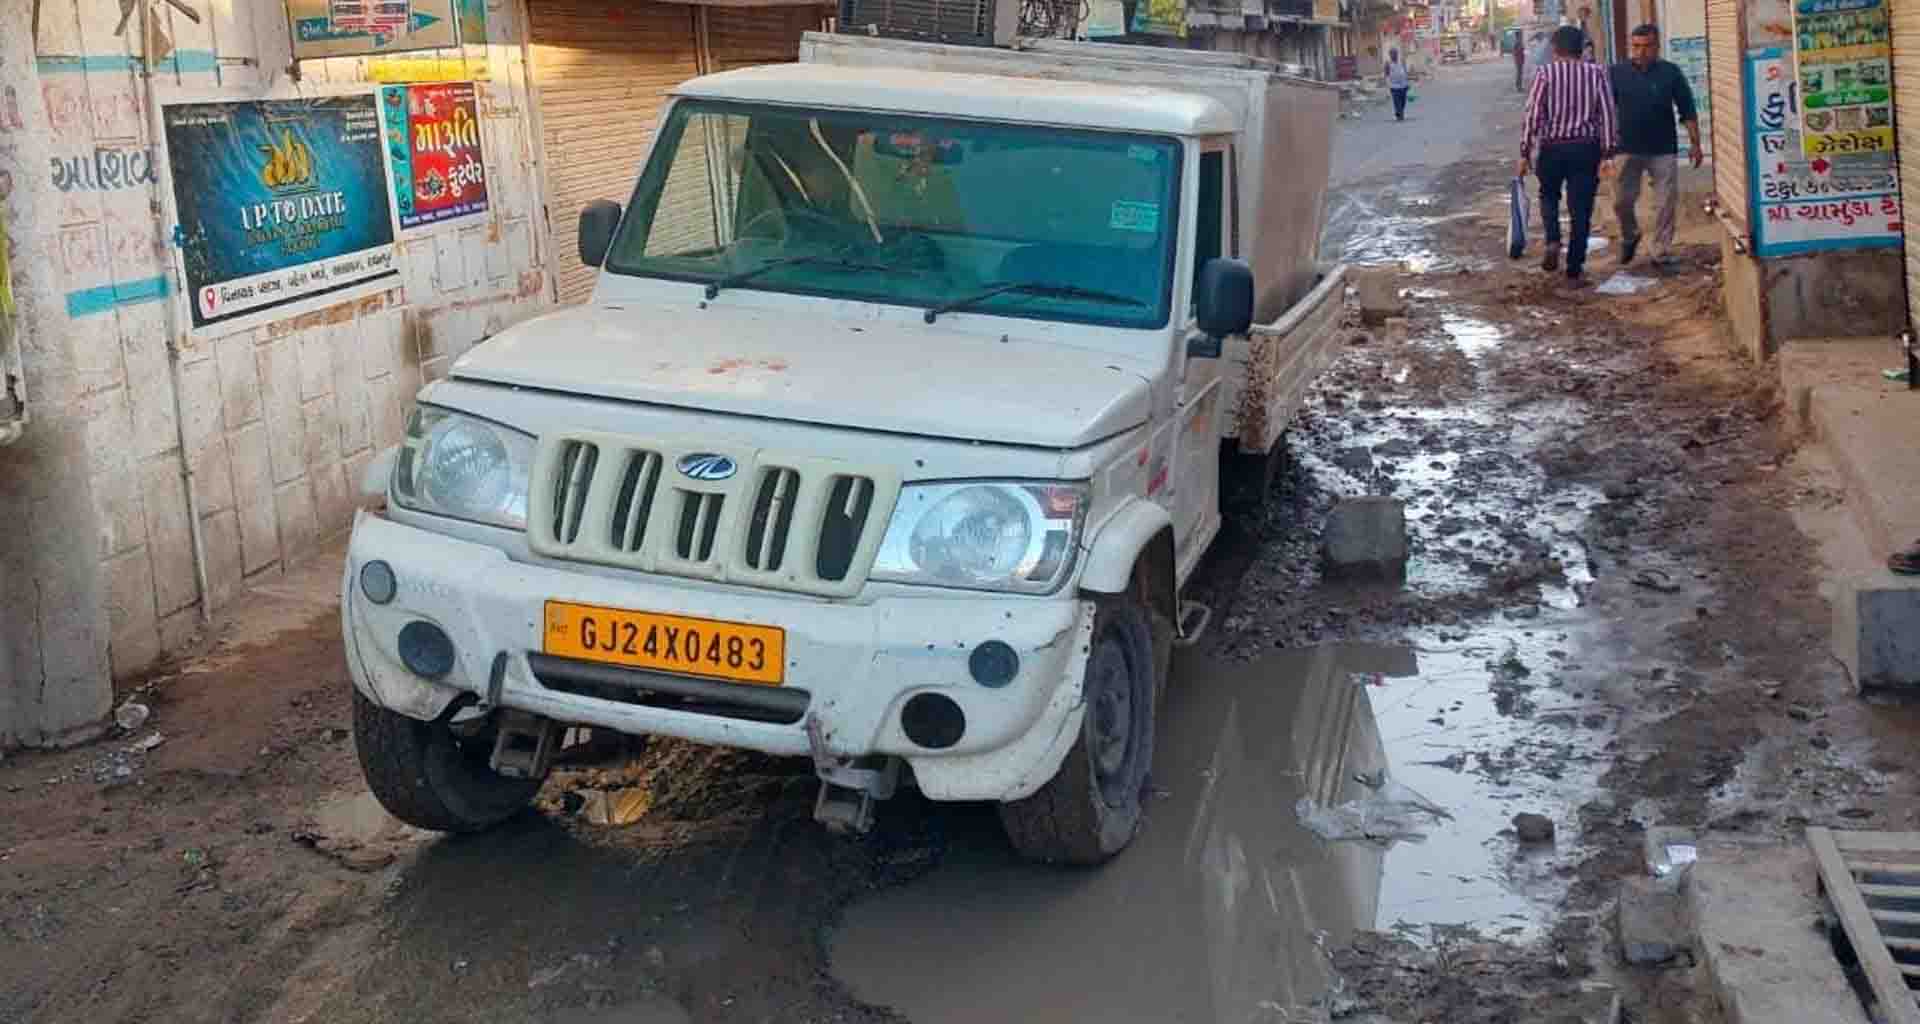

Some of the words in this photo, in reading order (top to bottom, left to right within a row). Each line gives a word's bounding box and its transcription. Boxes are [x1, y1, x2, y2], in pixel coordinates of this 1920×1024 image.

[269, 199, 297, 223] TO
[301, 191, 346, 222] DATE
[580, 616, 766, 670] GJ24X0483
